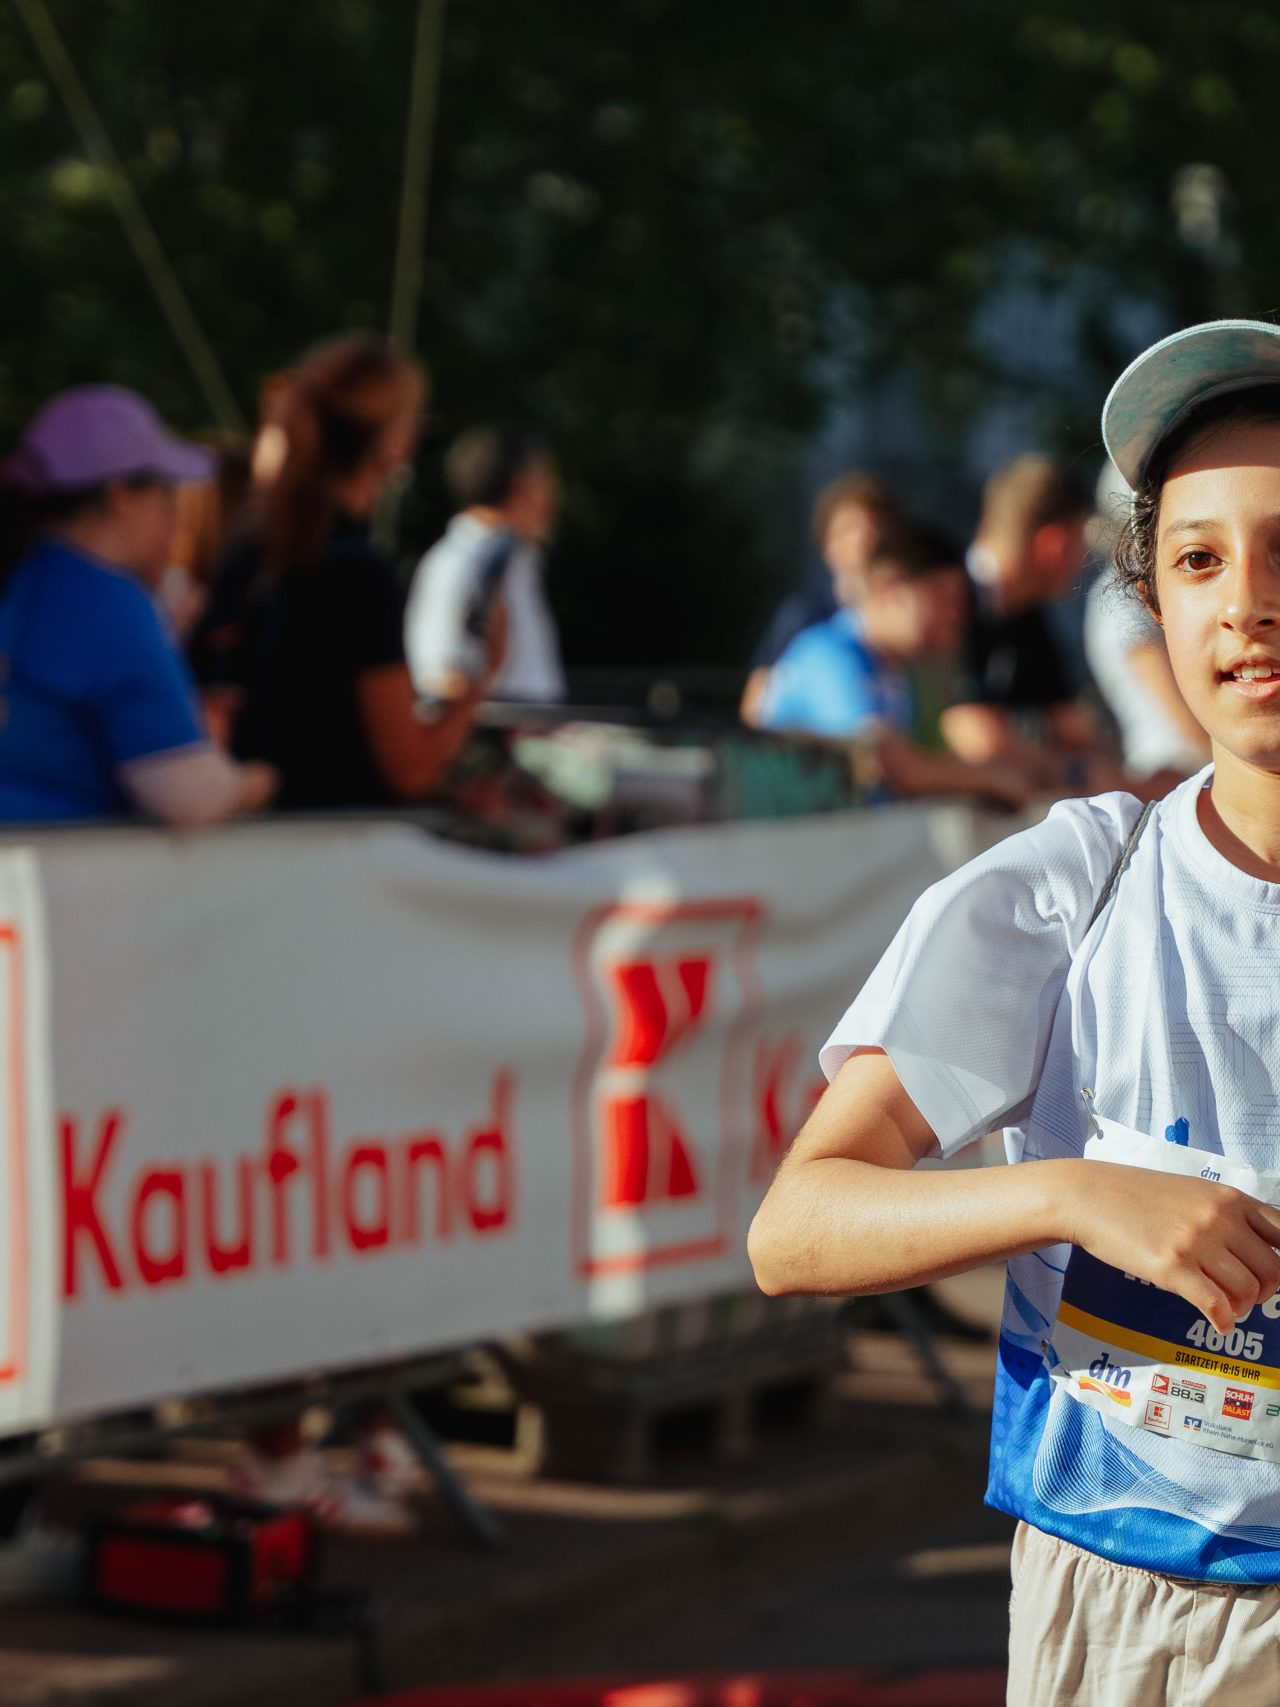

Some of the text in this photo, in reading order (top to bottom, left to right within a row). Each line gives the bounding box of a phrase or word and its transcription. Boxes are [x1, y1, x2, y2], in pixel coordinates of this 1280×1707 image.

[58, 1064, 518, 1302] Kaufland
[1200, 1166, 1221, 1182] dm
[1186, 1319, 1264, 1361] 4605
[1088, 1352, 1131, 1389] dm
[1175, 1351, 1261, 1381] STARTZEIT 18:15 UHR
[1170, 1386, 1205, 1403] 88.3
[1225, 1390, 1254, 1402] SCHUH
[1223, 1405, 1251, 1417] PALAST
